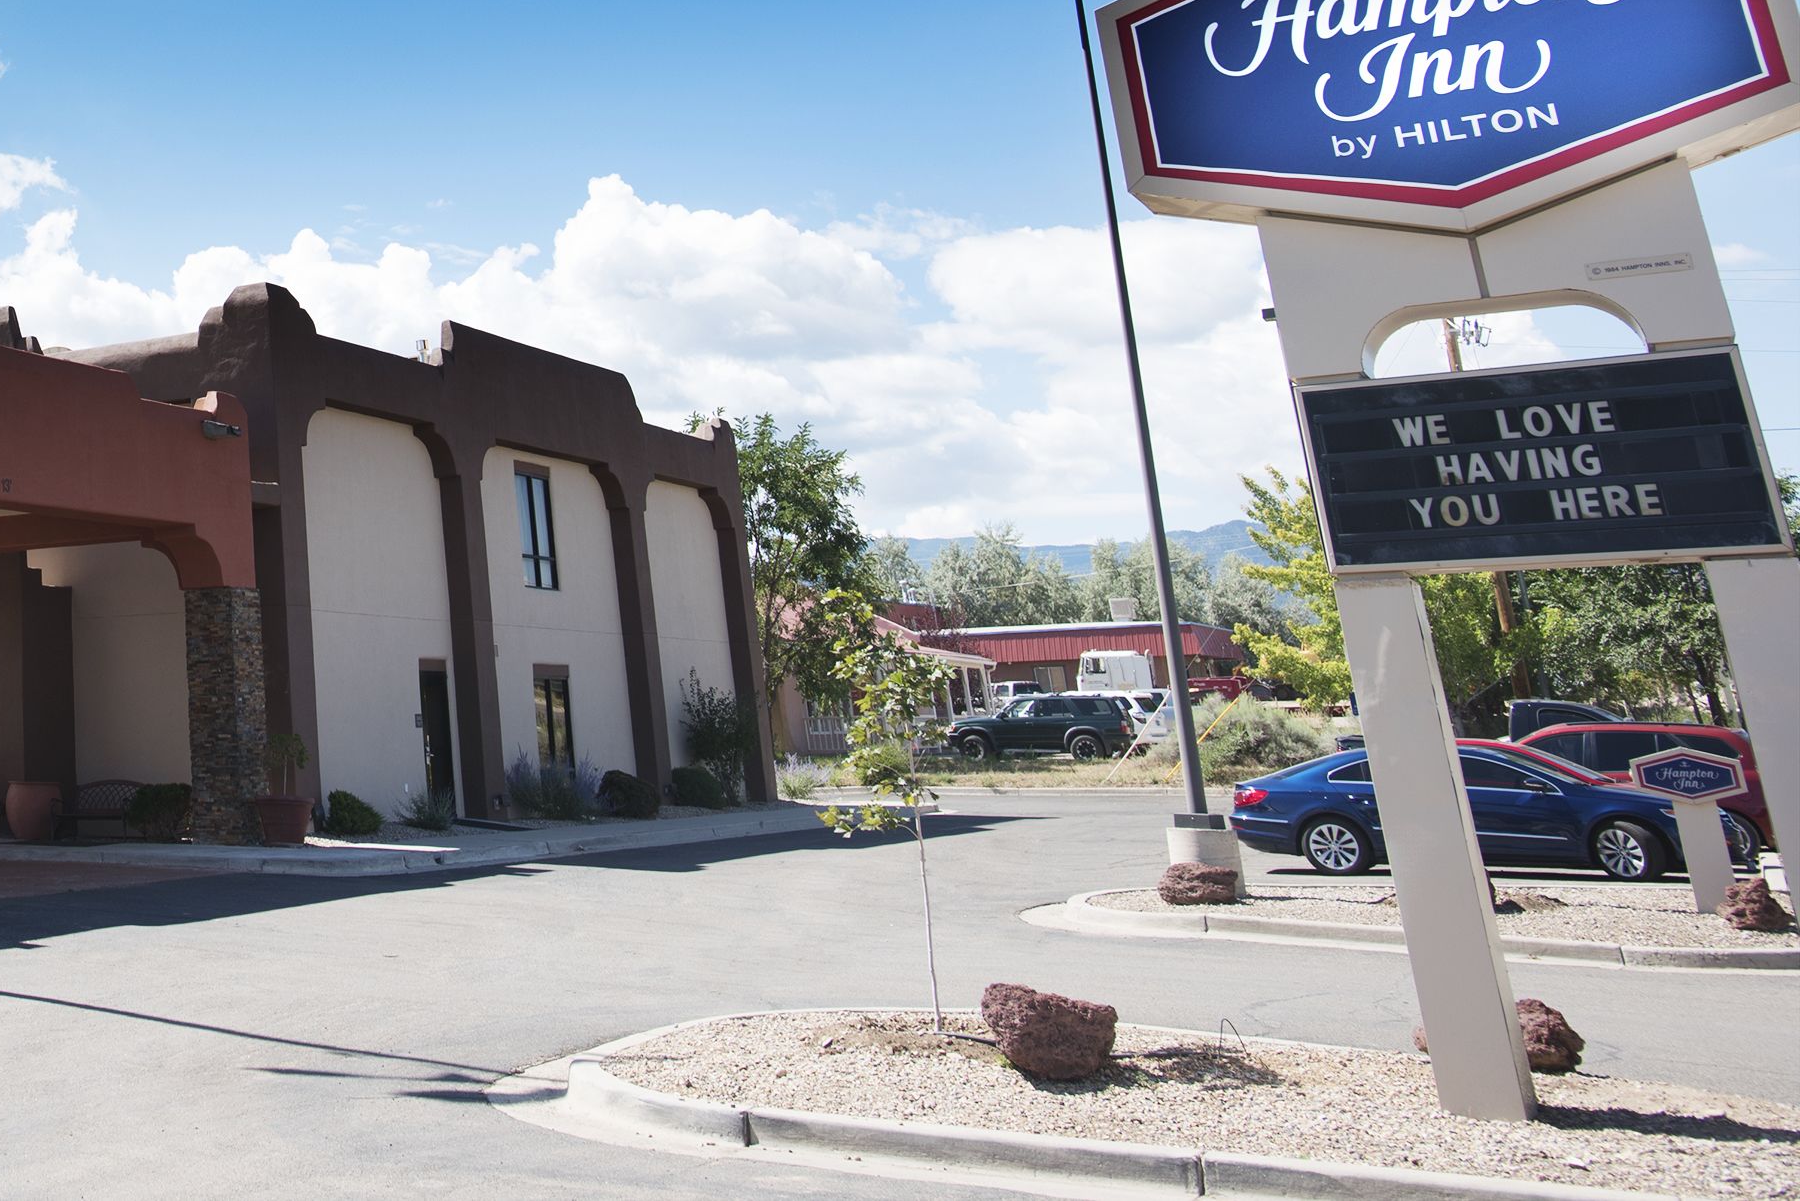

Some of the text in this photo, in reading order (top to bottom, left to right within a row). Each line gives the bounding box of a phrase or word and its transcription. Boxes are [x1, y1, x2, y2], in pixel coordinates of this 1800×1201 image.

[1315, 33, 1551, 122] Inn
[1332, 103, 1560, 159] by HILTON
[1621, 262, 1652, 271] HAMPTON
[1393, 401, 1616, 447] WE LOVE
[1436, 444, 1603, 486] HAVING
[1410, 484, 1664, 528] YOU HERE
[1656, 767, 1720, 781] Hampton
[1673, 778, 1703, 791] Inn
